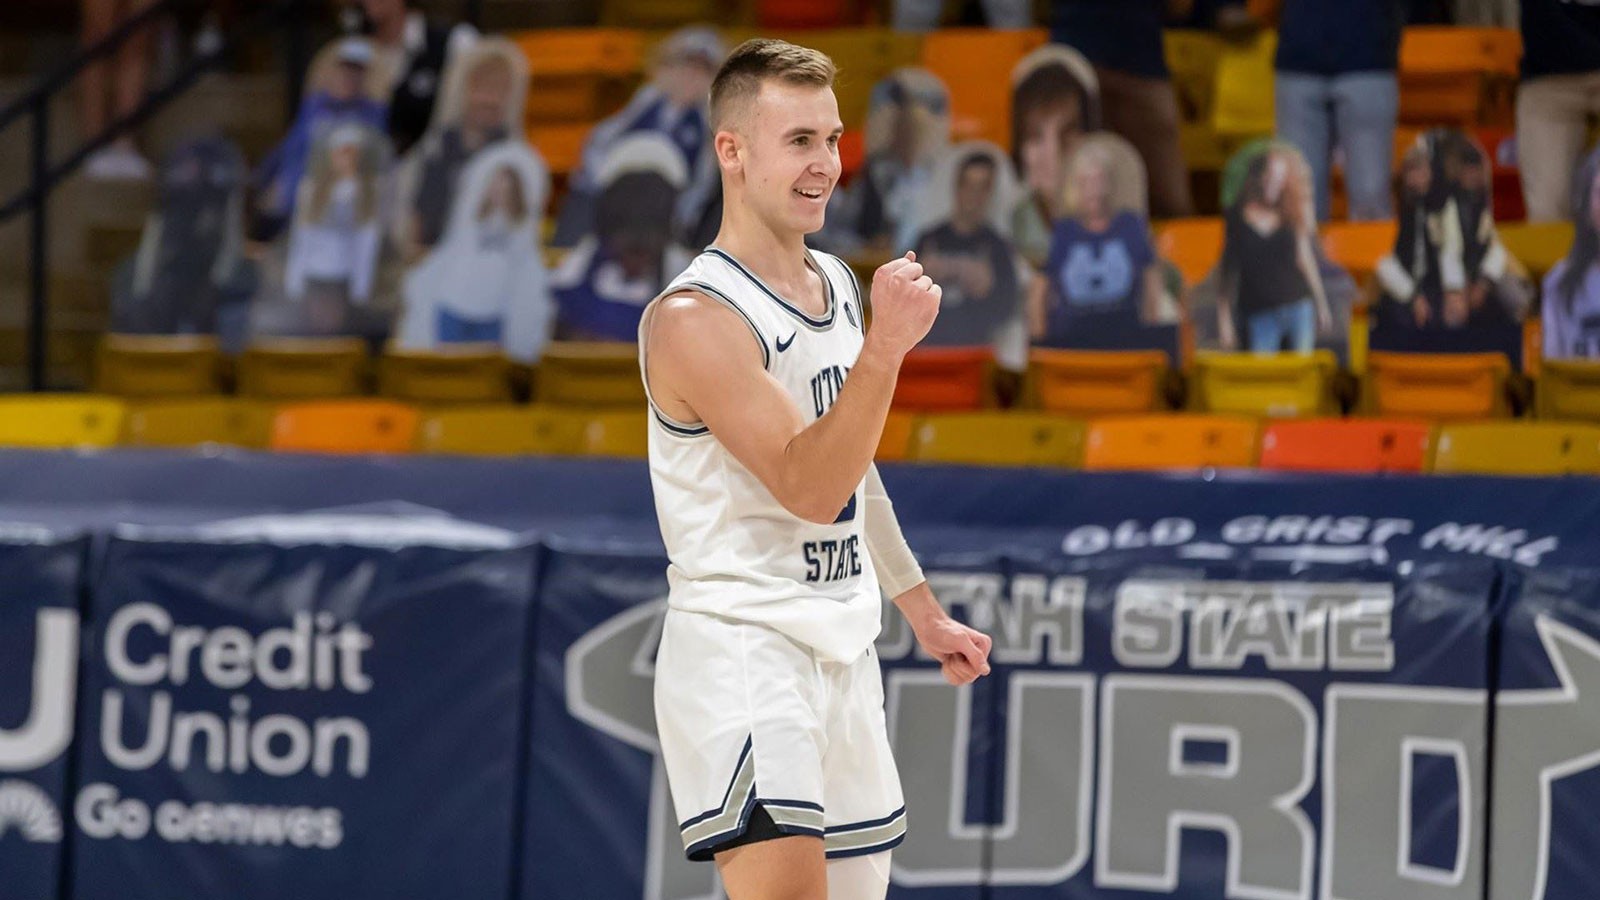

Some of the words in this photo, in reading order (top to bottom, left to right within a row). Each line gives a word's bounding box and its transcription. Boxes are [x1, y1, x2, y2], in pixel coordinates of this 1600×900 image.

[811, 365, 849, 418] UTA
[803, 534, 861, 582] STATE
[1062, 517, 1196, 555] OLD
[1221, 515, 1414, 544] GRIST
[103, 602, 373, 692] Credit
[1114, 579, 1395, 670] STATE
[100, 690, 371, 776] Union
